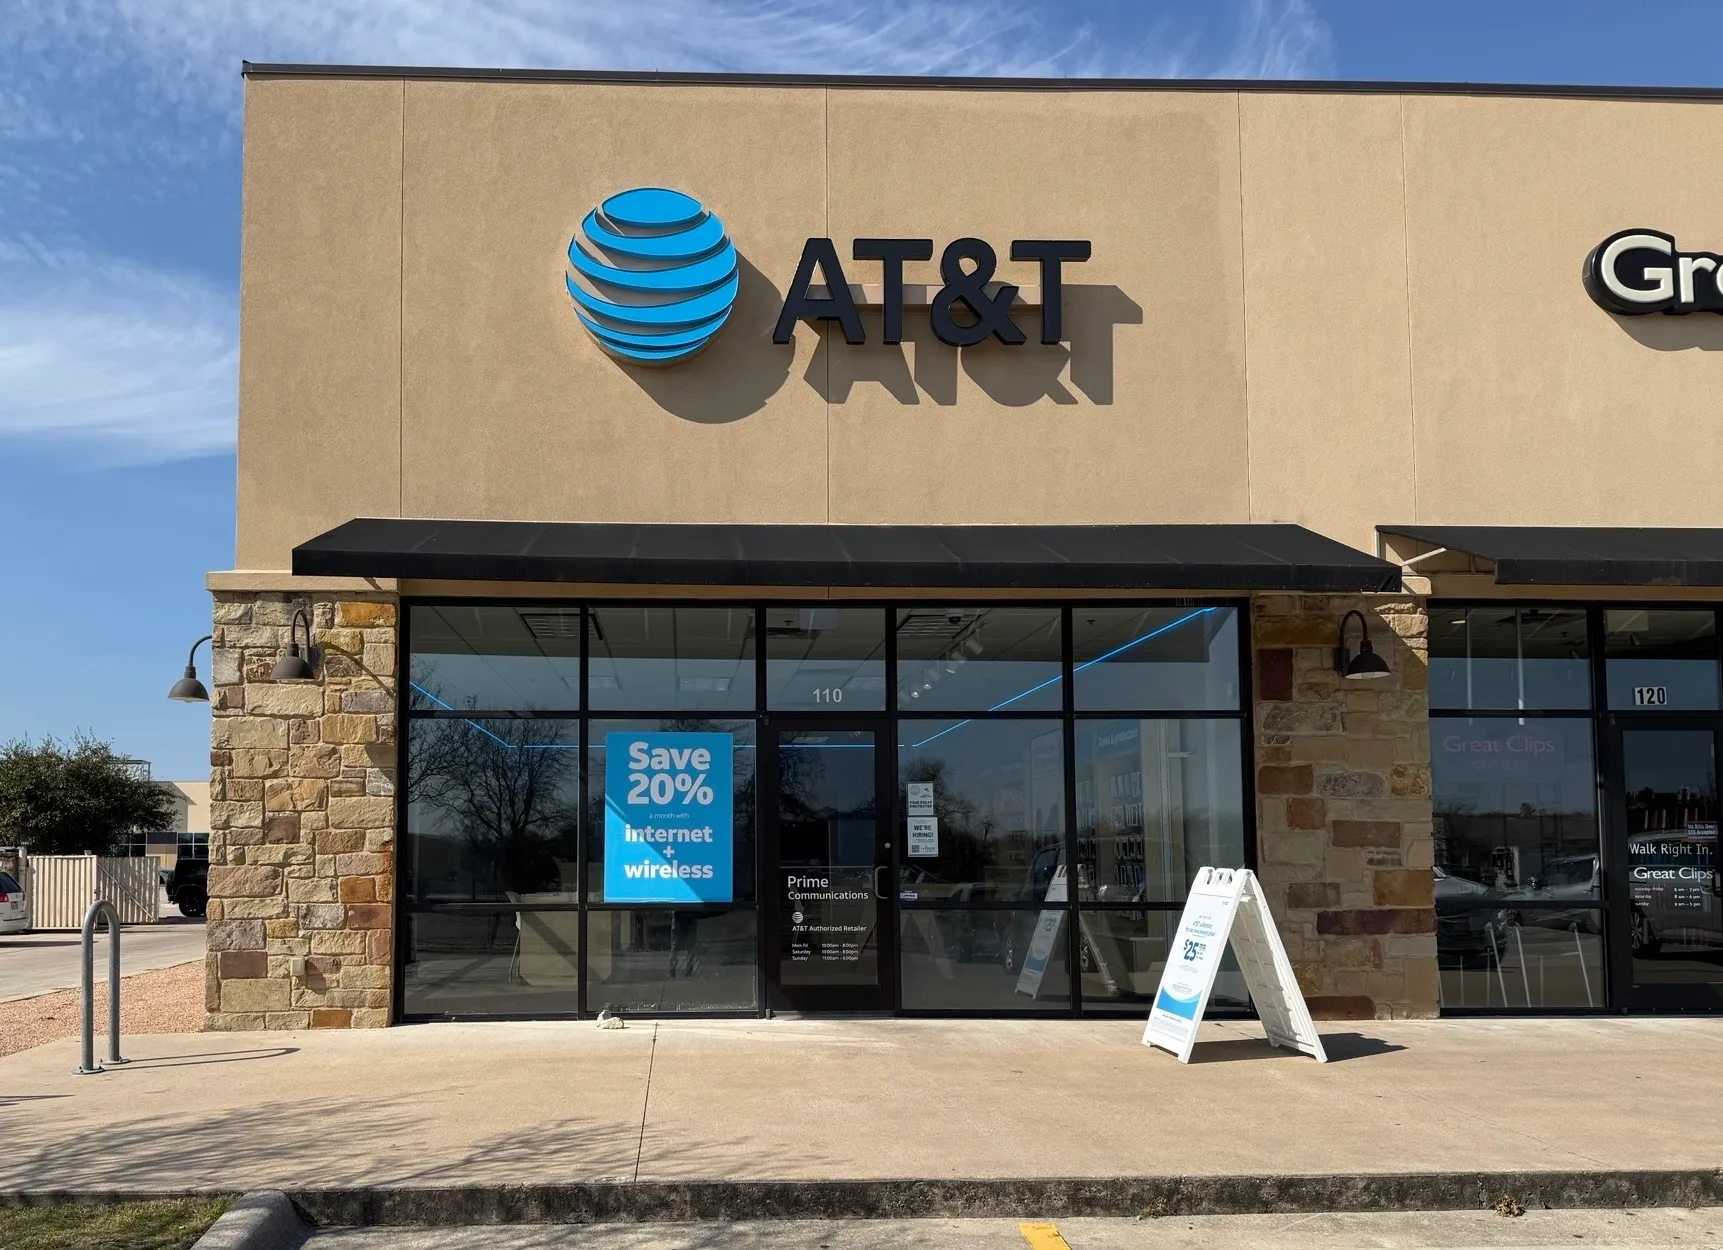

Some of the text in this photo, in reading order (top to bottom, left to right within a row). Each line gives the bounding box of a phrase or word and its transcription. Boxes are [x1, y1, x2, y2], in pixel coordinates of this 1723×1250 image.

[1600, 234, 1723, 303] Gr
[772, 237, 1091, 347] AT&T
[812, 688, 843, 704] 110
[1637, 687, 1666, 705] 120
[1442, 733, 1556, 758] Great Clips
[628, 741, 711, 770] Save
[627, 773, 714, 805] 20%
[675, 811, 690, 819] with
[624, 824, 713, 842] internet
[1629, 843, 1713, 857] Walk Right In.
[624, 859, 714, 879] wireless
[1633, 866, 1714, 882] Great Clips
[787, 875, 829, 888] Prime
[787, 890, 869, 900] Communications
[1183, 937, 1199, 961] $25
